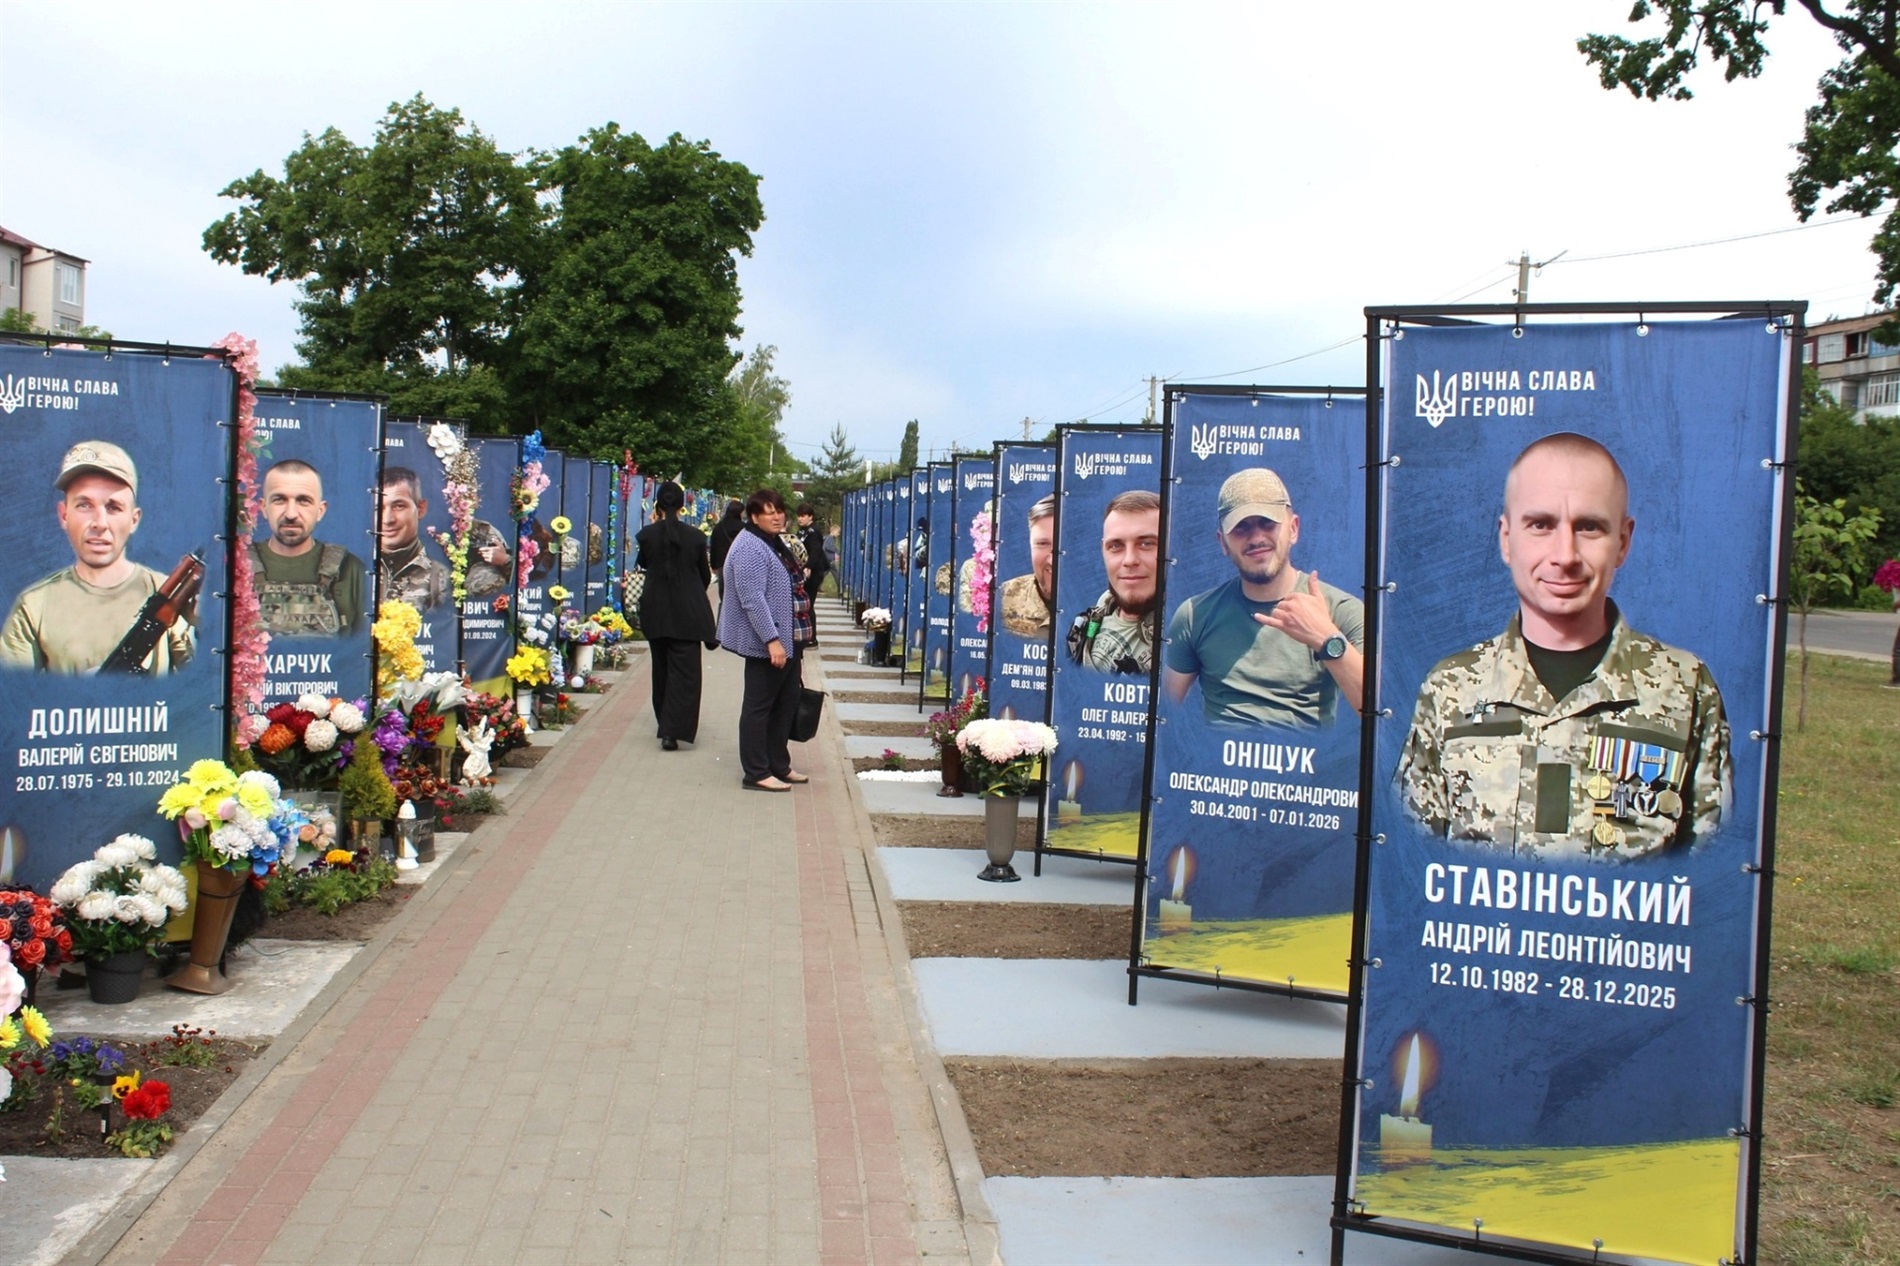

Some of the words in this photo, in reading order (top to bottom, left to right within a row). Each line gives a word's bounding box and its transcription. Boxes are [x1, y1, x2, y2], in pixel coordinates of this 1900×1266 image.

[27, 376, 70, 393] ВІЧНА
[74, 379, 119, 396] СЛАВА
[1461, 370, 1521, 392] ВІЧНА
[1528, 370, 1596, 391] СЛАВА
[27, 394, 79, 411] ГЕРОЮ!
[1460, 396, 1535, 417] ГЕРОЮ!
[269, 418, 301, 430] СЛАВА
[1218, 424, 1256, 440] ВІЧНА
[1259, 426, 1301, 441] СЛАВА
[1218, 440, 1264, 456] ГЕРОЮ!
[1024, 463, 1046, 473] ВІЧНА
[1094, 453, 1121, 464] ВІЧНА
[1123, 454, 1153, 465] СЛАВА
[1024, 472, 1050, 482] ГЕРОЮ!
[1093, 464, 1127, 476] ГЕРОЮ!
[1023, 643, 1048, 660] КОС
[263, 653, 333, 675] ХАРЧУК
[275, 680, 338, 696] ВІКТОРОВИЧ
[1104, 682, 1151, 705] КОВТ
[28, 700, 169, 740] ДОЛИШНІЙ
[1081, 707, 1109, 724] ОЛЕГ
[1110, 710, 1149, 727] ВАЛЕР
[1077, 726, 1127, 742] 23.04.1992
[18, 742, 85, 768] ВАЛЕРІЙ
[90, 743, 178, 765] ЄВГЕНОВИЧ
[1222, 739, 1317, 775] ОНІЩУК
[16, 773, 94, 792] 28.07.1975
[106, 770, 180, 788] 29.10.2024
[1169, 771, 1249, 798] ОЛЕКСАНДР
[1251, 780, 1360, 809] ОЛЕКСАНДРОВИ
[1189, 799, 1258, 822] 30.04.2001
[1269, 808, 1341, 831] 07.01.2026
[1424, 862, 1692, 927] СТАВІНСЬКИЙ
[1421, 920, 1511, 956] АНДРІЙ
[1517, 929, 1692, 974] ЛЕОНТІЙОВИЧ
[1429, 961, 1539, 995] 12.10.1982
[1558, 975, 1677, 1010] 28.12.2025
